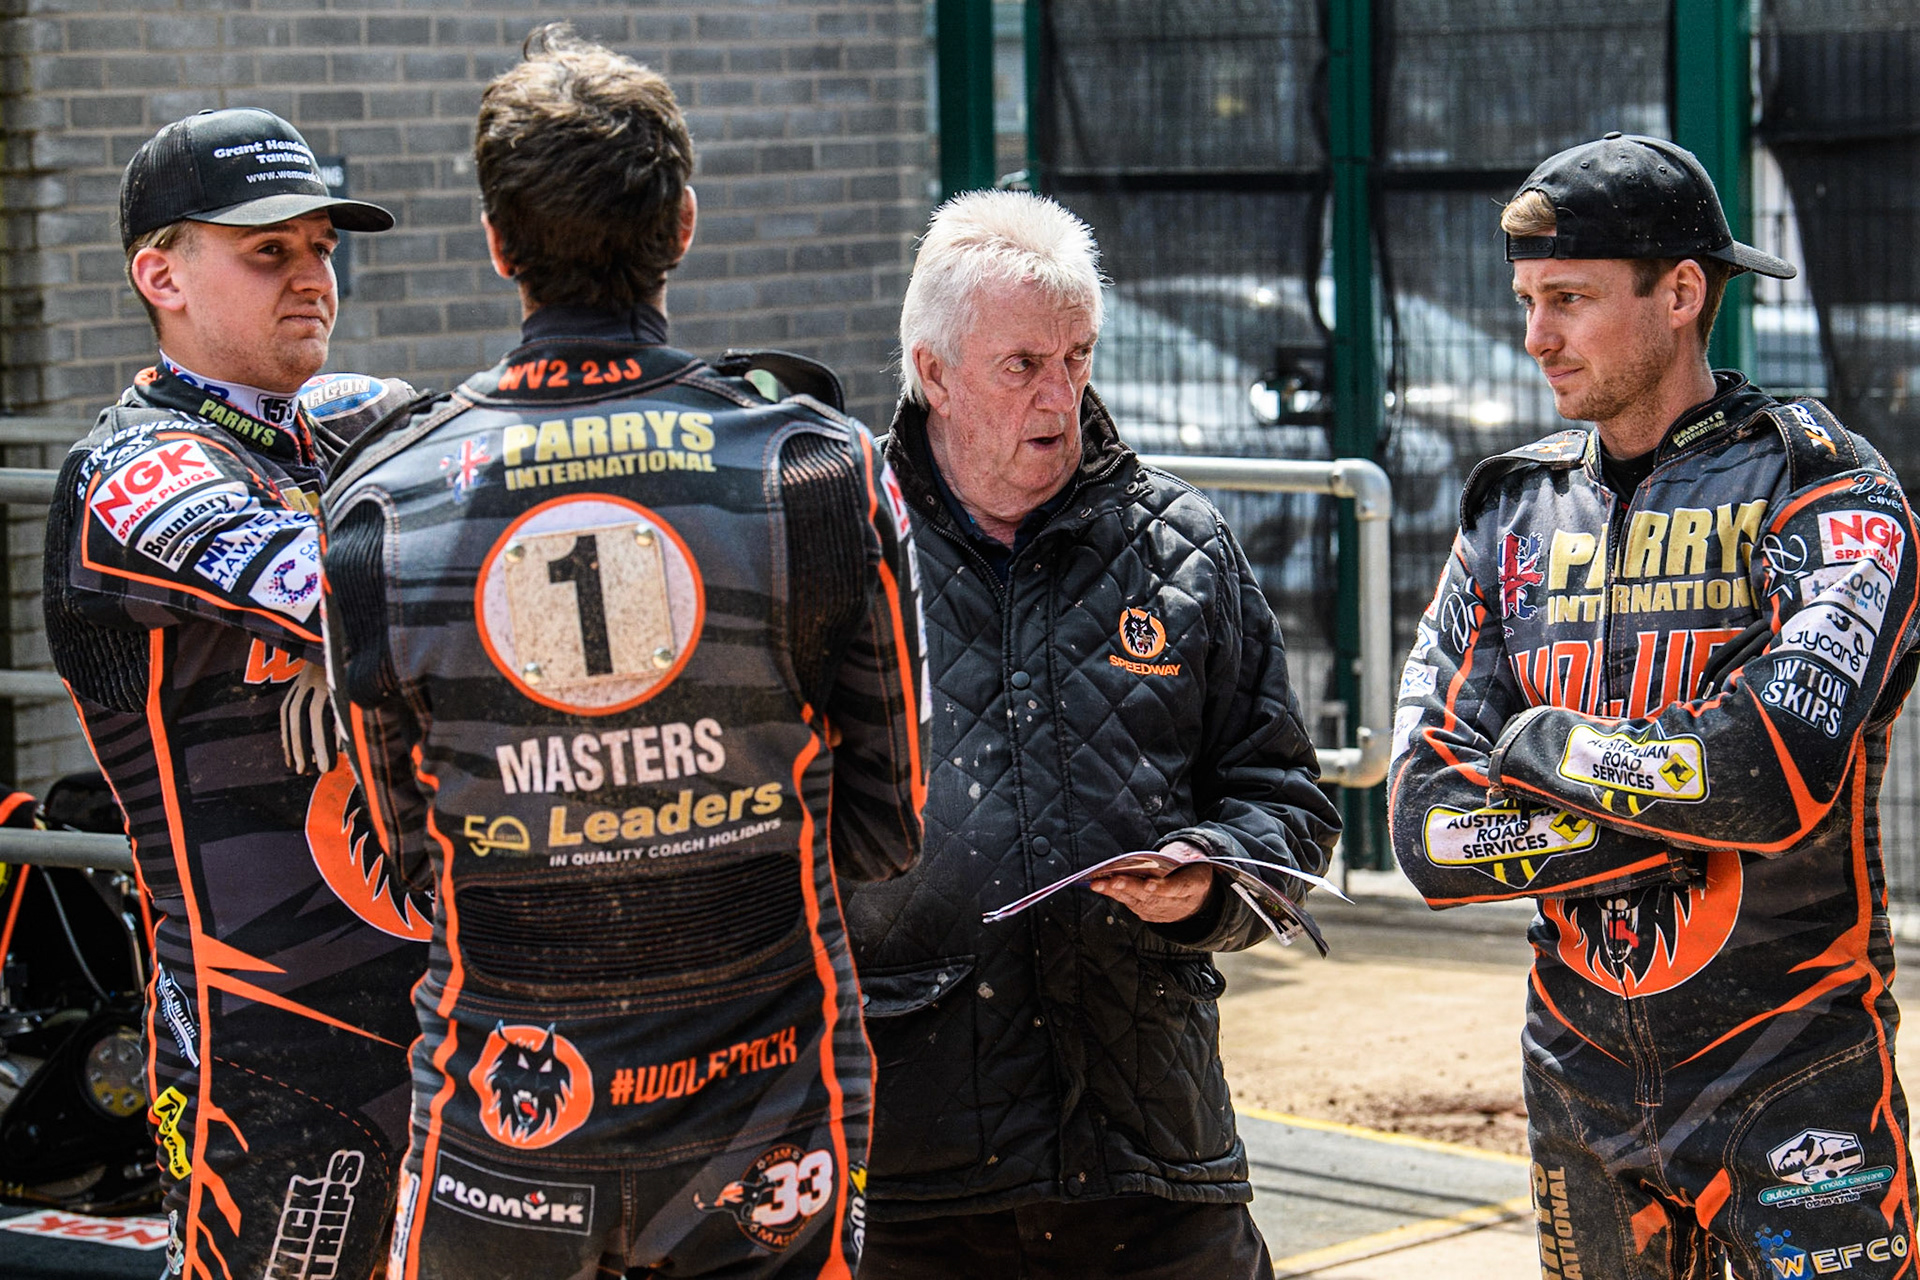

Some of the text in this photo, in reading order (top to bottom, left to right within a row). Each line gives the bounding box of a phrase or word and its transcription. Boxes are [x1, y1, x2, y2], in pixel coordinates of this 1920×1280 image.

[214, 142, 264, 159] Grant
[498, 358, 643, 391] WV2 2JJ
[199, 398, 276, 448] PARRYS
[502, 410, 716, 467] PARRYS
[93, 443, 206, 530] NGK
[504, 450, 717, 491] INTERNATIONAL
[117, 470, 216, 540] SPARK PLUGS
[143, 494, 231, 560] Boundary
[199, 537, 235, 574] NH
[1829, 514, 1902, 565] NGK
[547, 534, 613, 677] 1
[1109, 654, 1182, 676] SPEEDWAY
[1765, 682, 1841, 735] SKIPS
[496, 717, 727, 795] MASTERS
[1592, 765, 1656, 790] SERVICES
[1601, 751, 1643, 771] ROAD
[548, 781, 784, 848] Leaders
[1476, 825, 1530, 843] ROAD
[550, 817, 782, 867] IN QUALITY COACH HOLIDAYS
[1462, 833, 1549, 860] SERVICES
[751, 1149, 833, 1227] 33
[1770, 1234, 1908, 1279] WEFCO
